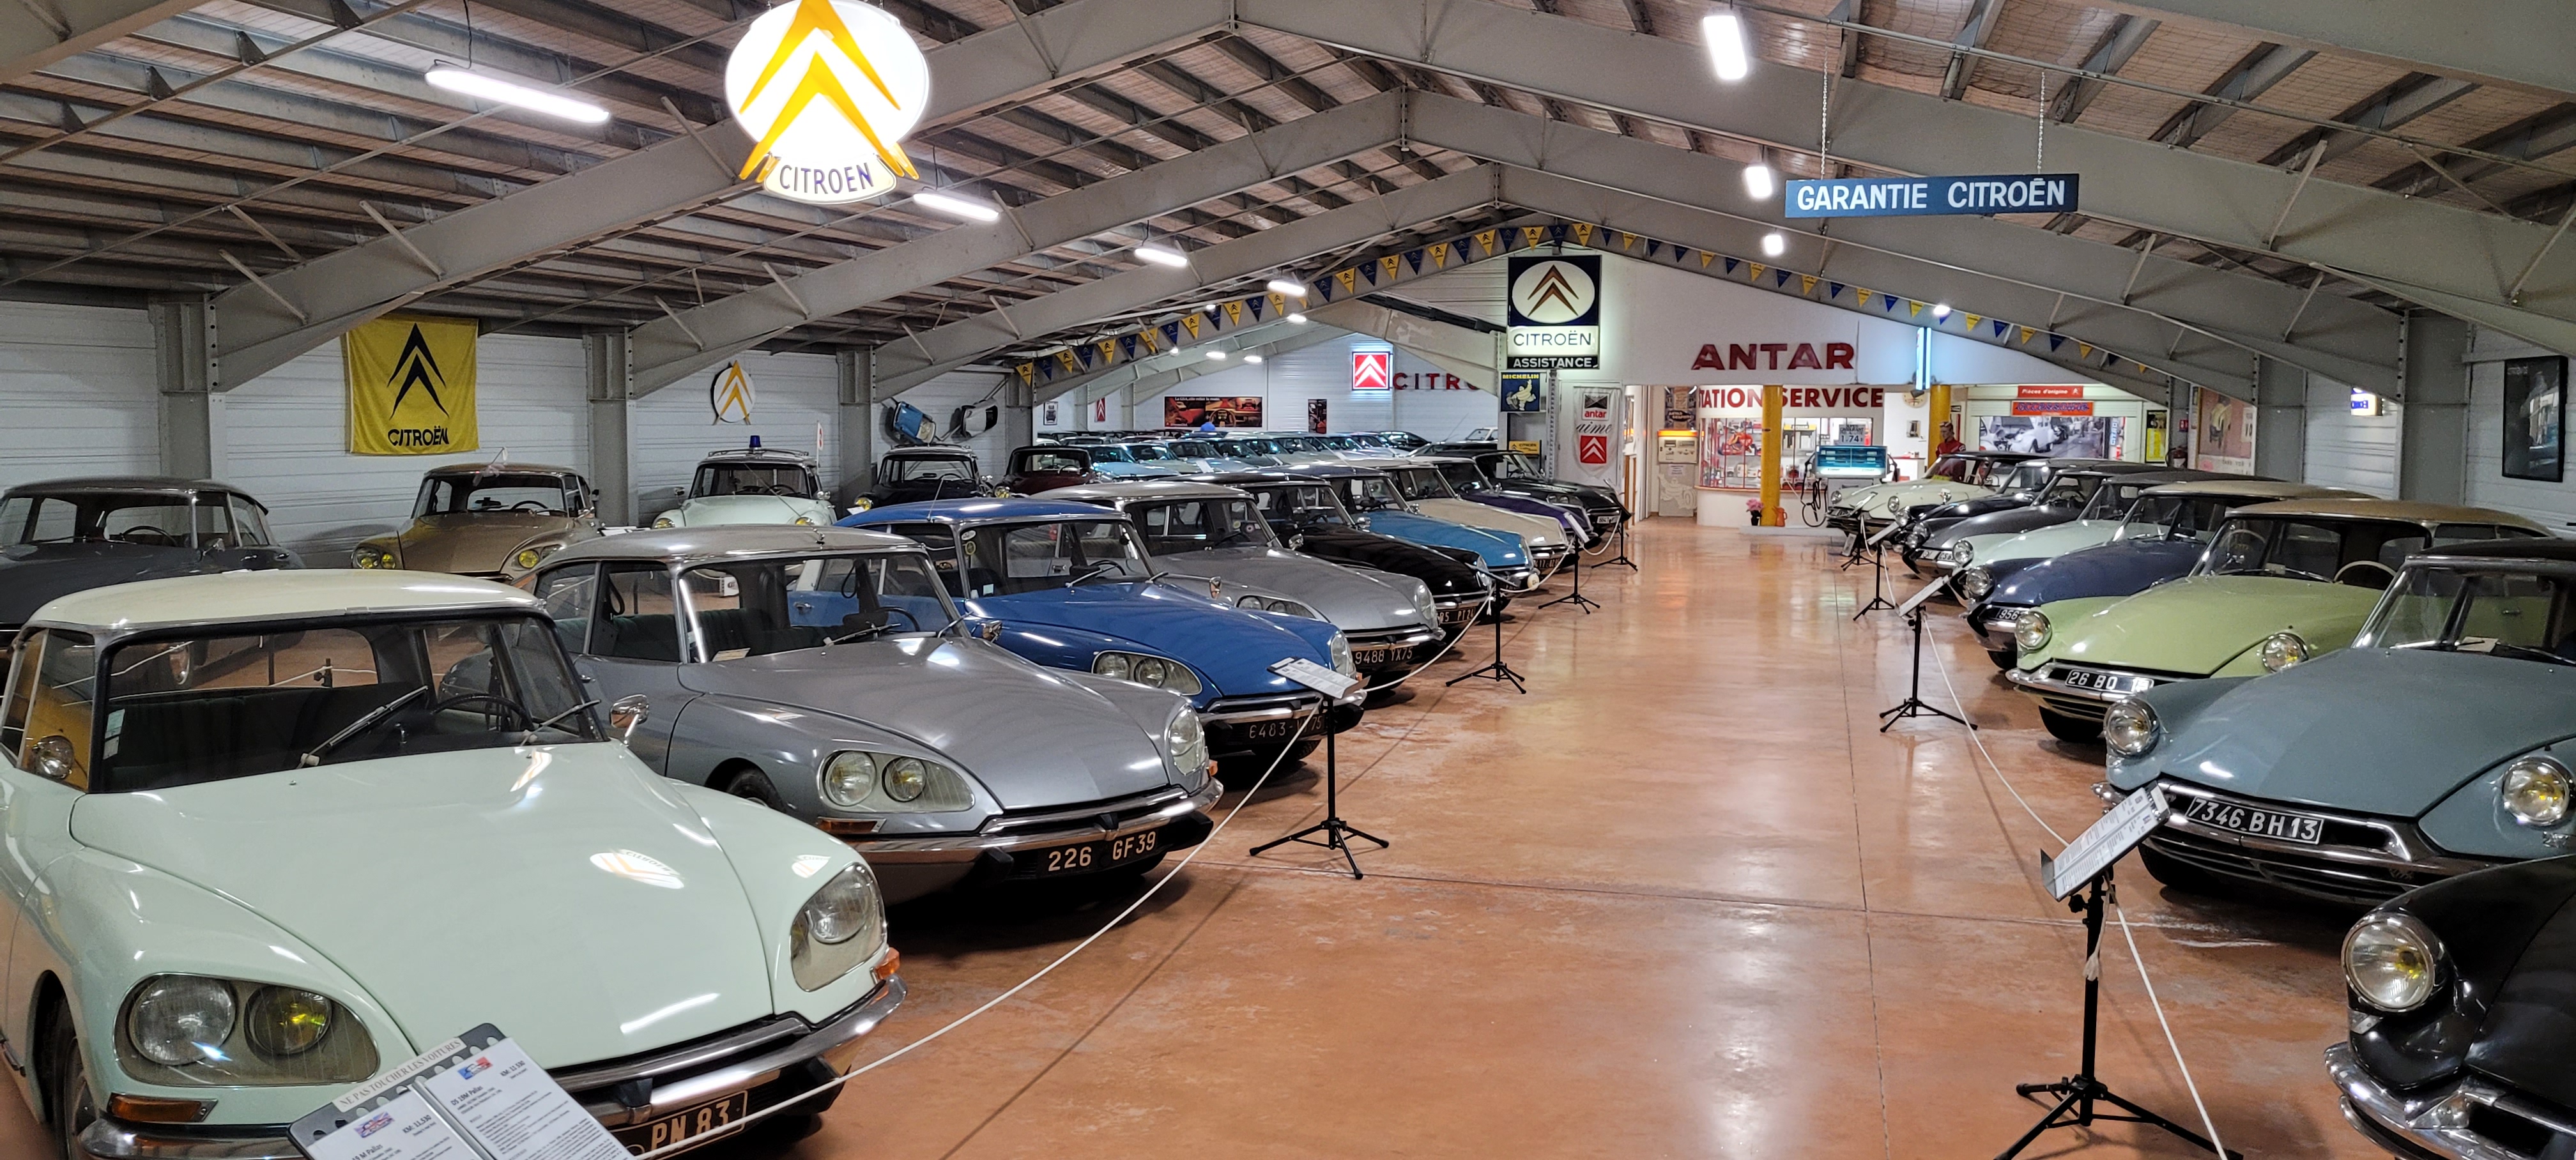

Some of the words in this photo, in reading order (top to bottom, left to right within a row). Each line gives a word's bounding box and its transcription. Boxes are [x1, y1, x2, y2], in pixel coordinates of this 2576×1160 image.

[1797, 183, 1928, 211] GARANTIE
[1948, 178, 2064, 208] CITROËN
[1514, 330, 1591, 346] CITROËN
[1513, 358, 1592, 368] ASSISTANCE
[1691, 343, 1854, 370] ANTAR
[1393, 372, 1480, 390] CITR
[1699, 388, 1763, 408] TATION
[1584, 410, 1607, 418] antar
[388, 425, 449, 446] CITROËN
[1576, 422, 1612, 434] aime
[1999, 609, 2028, 620] 956
[1355, 650, 1384, 664] 9488
[2068, 671, 2090, 685] 26
[2188, 798, 2245, 828] 7346
[2248, 811, 2286, 836] BH
[2291, 817, 2318, 839] 13
[1048, 846, 1092, 871] 226
[339, 1095, 354, 1107] NE
[351, 1088, 371, 1101] PAS
[369, 1065, 411, 1092] TOUCHER
[408, 1059, 424, 1072] LES
[421, 1040, 462, 1064] VOITURES
[651, 1115, 687, 1151] PN
[696, 1099, 730, 1136] 83
